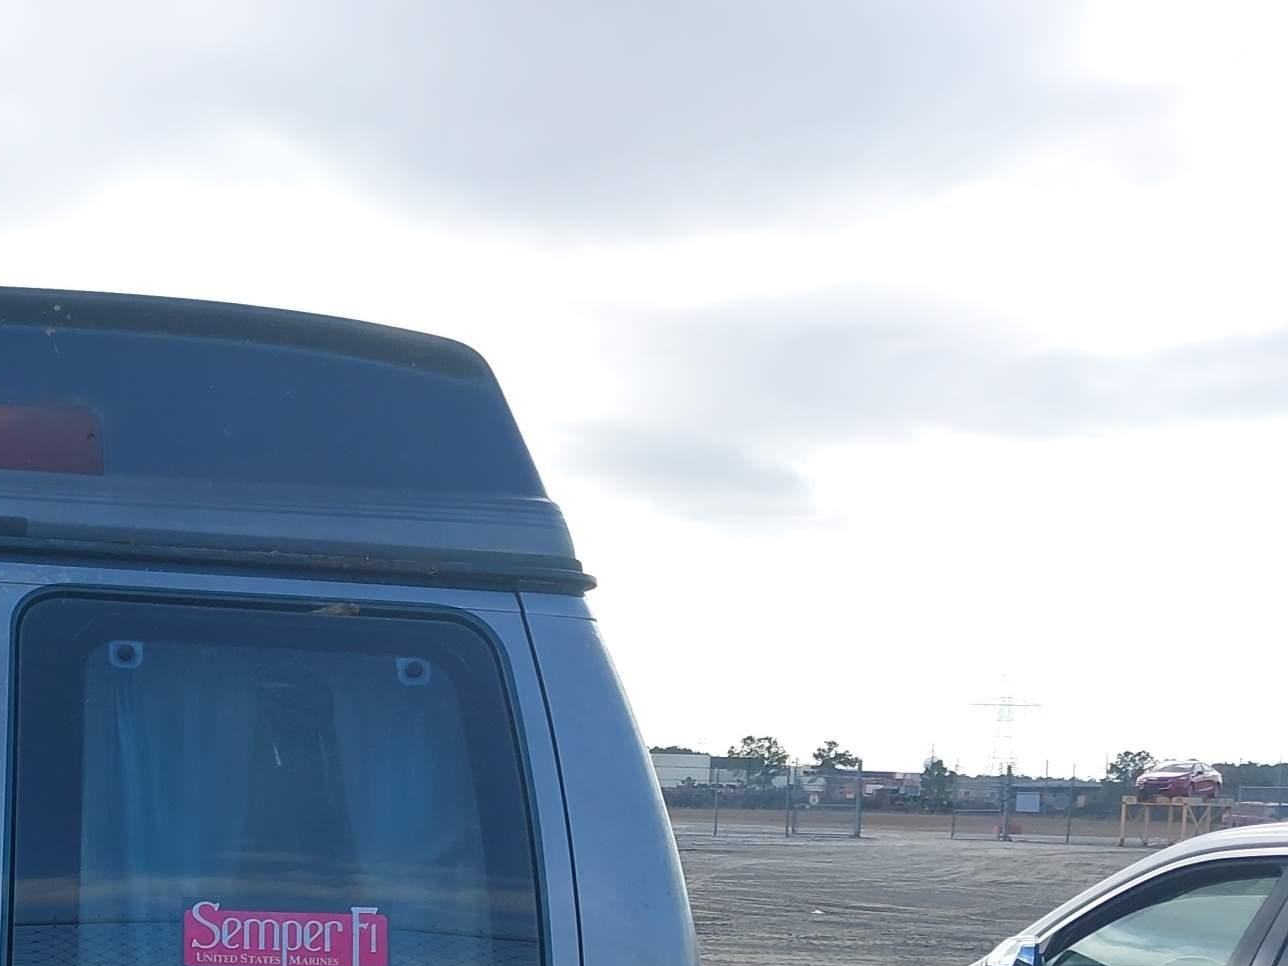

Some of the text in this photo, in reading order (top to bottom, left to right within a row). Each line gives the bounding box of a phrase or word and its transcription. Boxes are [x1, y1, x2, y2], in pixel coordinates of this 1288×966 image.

[196, 952, 339, 966] UNITED STATES MARINES
